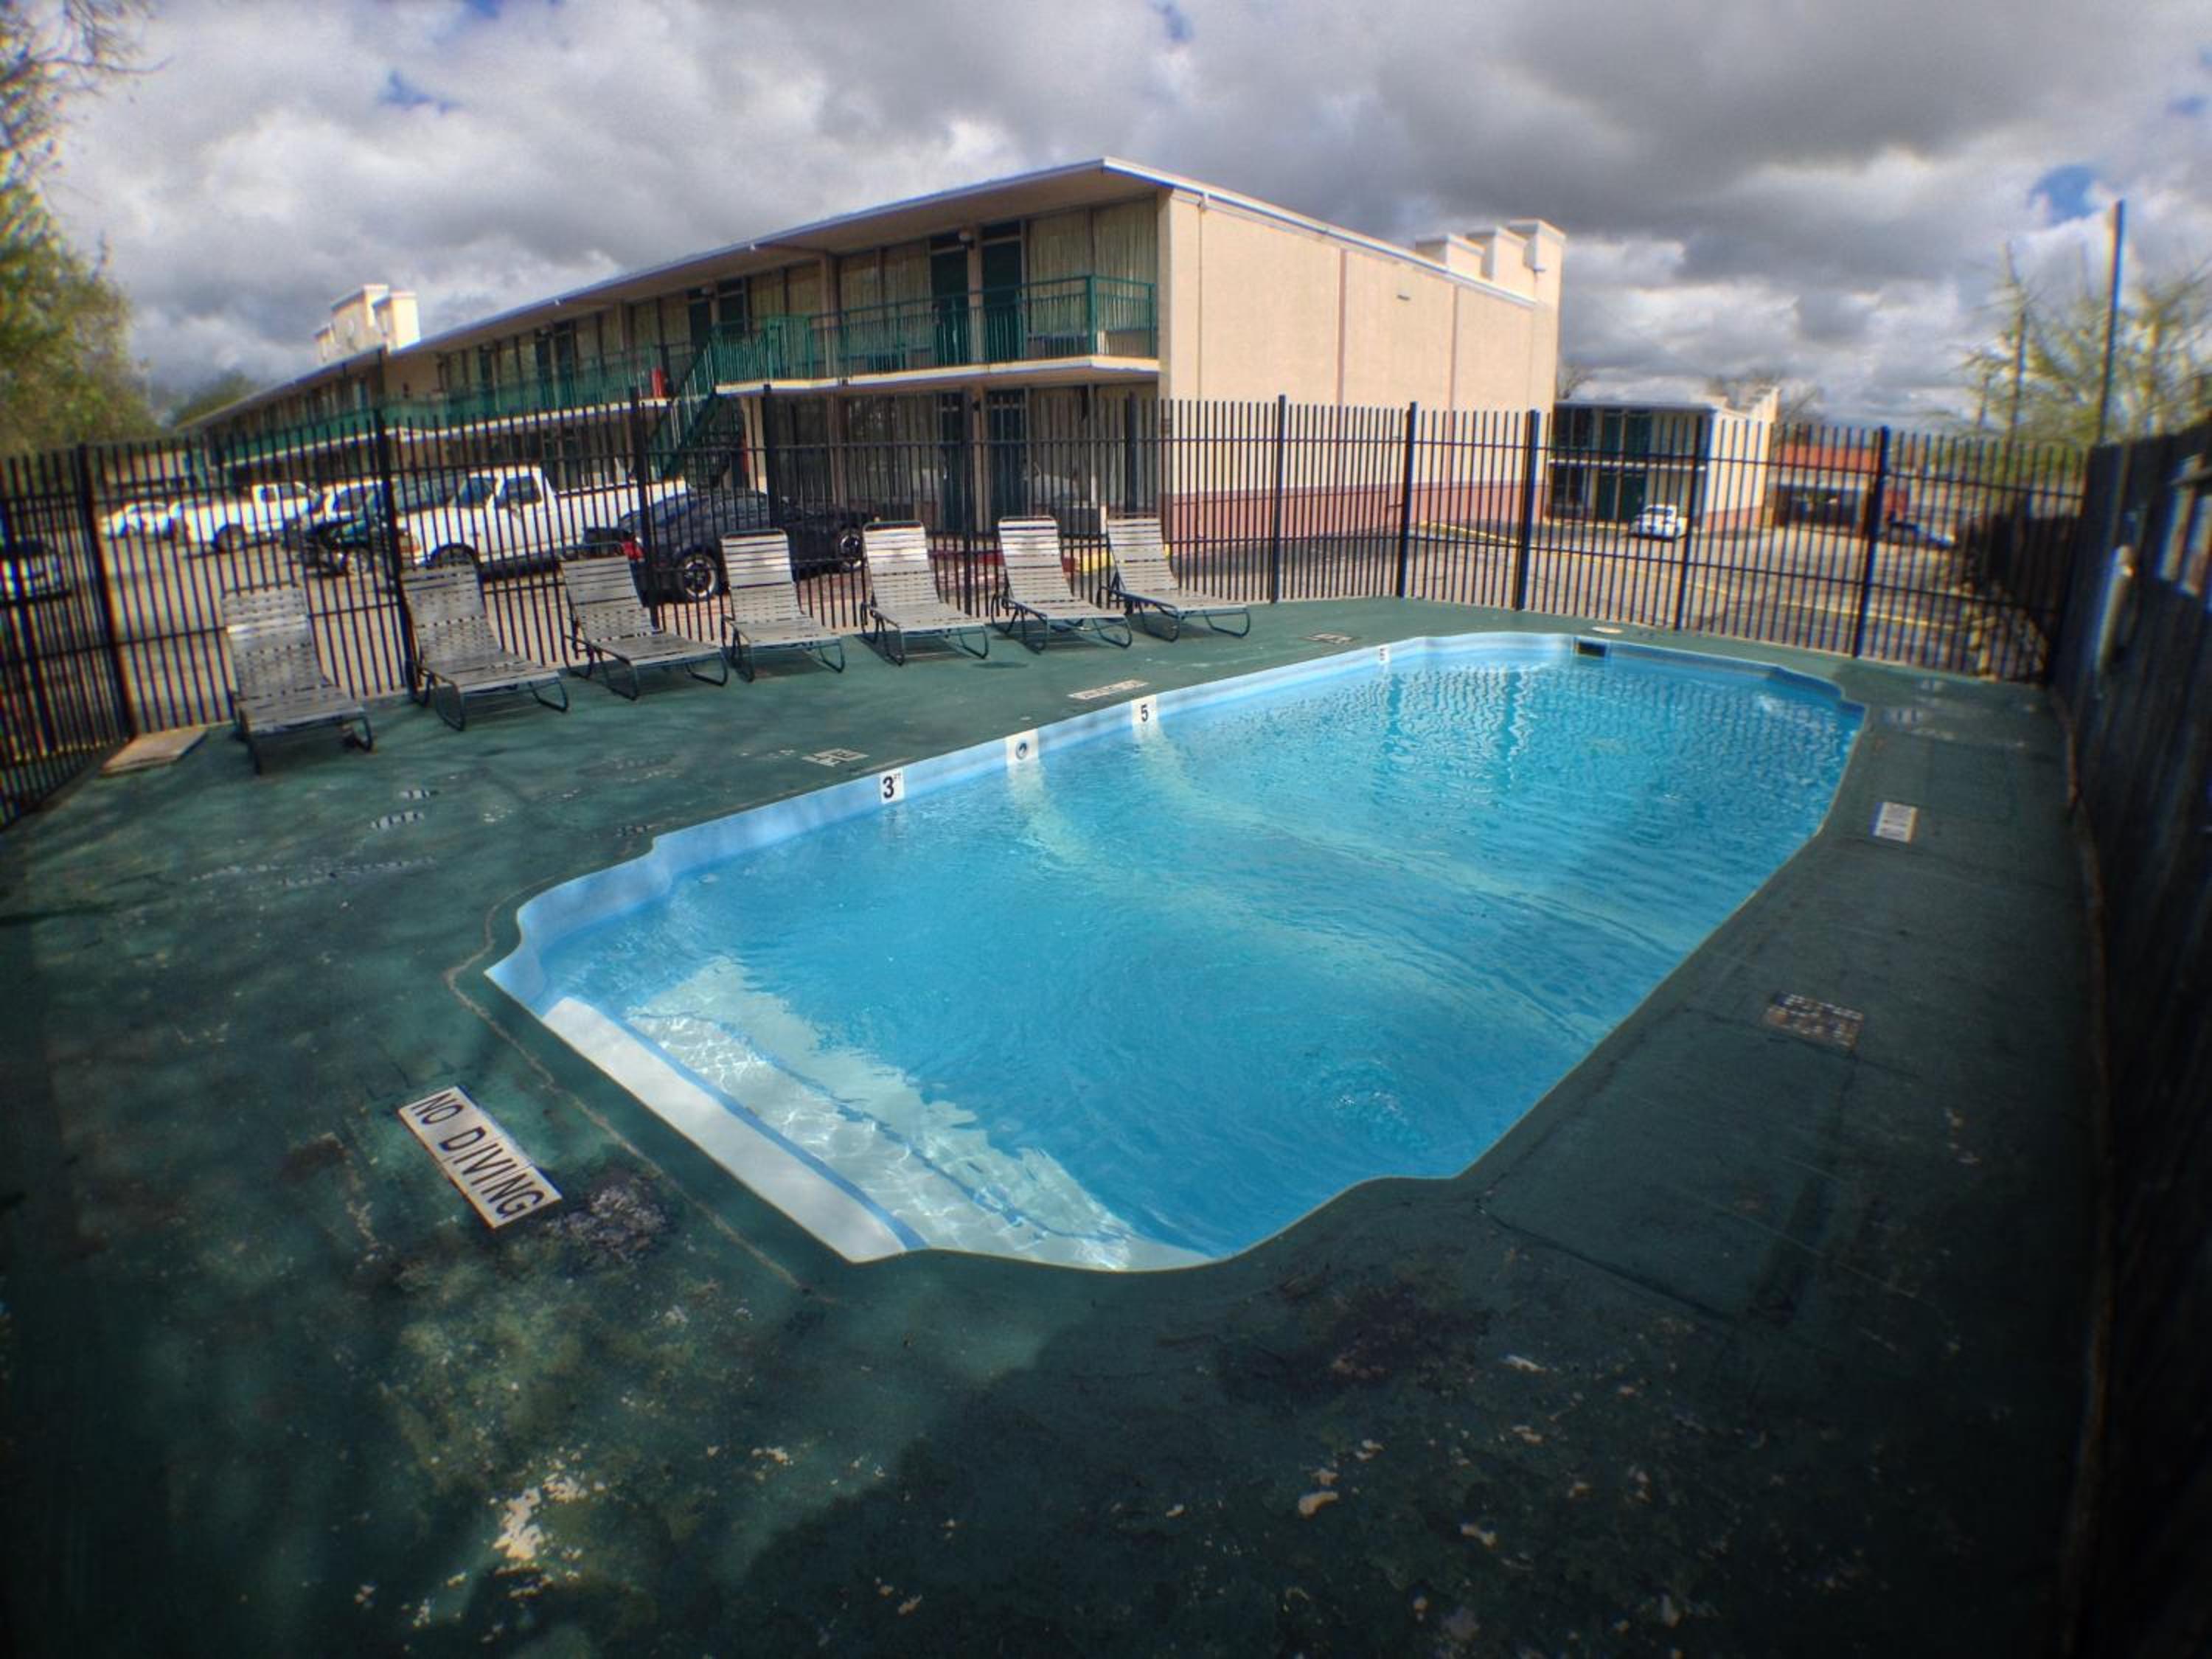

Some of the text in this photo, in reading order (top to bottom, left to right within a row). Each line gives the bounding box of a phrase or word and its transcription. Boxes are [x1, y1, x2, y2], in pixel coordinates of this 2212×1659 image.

[1141, 703, 1149, 722] 5
[883, 776, 894, 799] 3
[410, 1092, 546, 1219] NO DIVING
